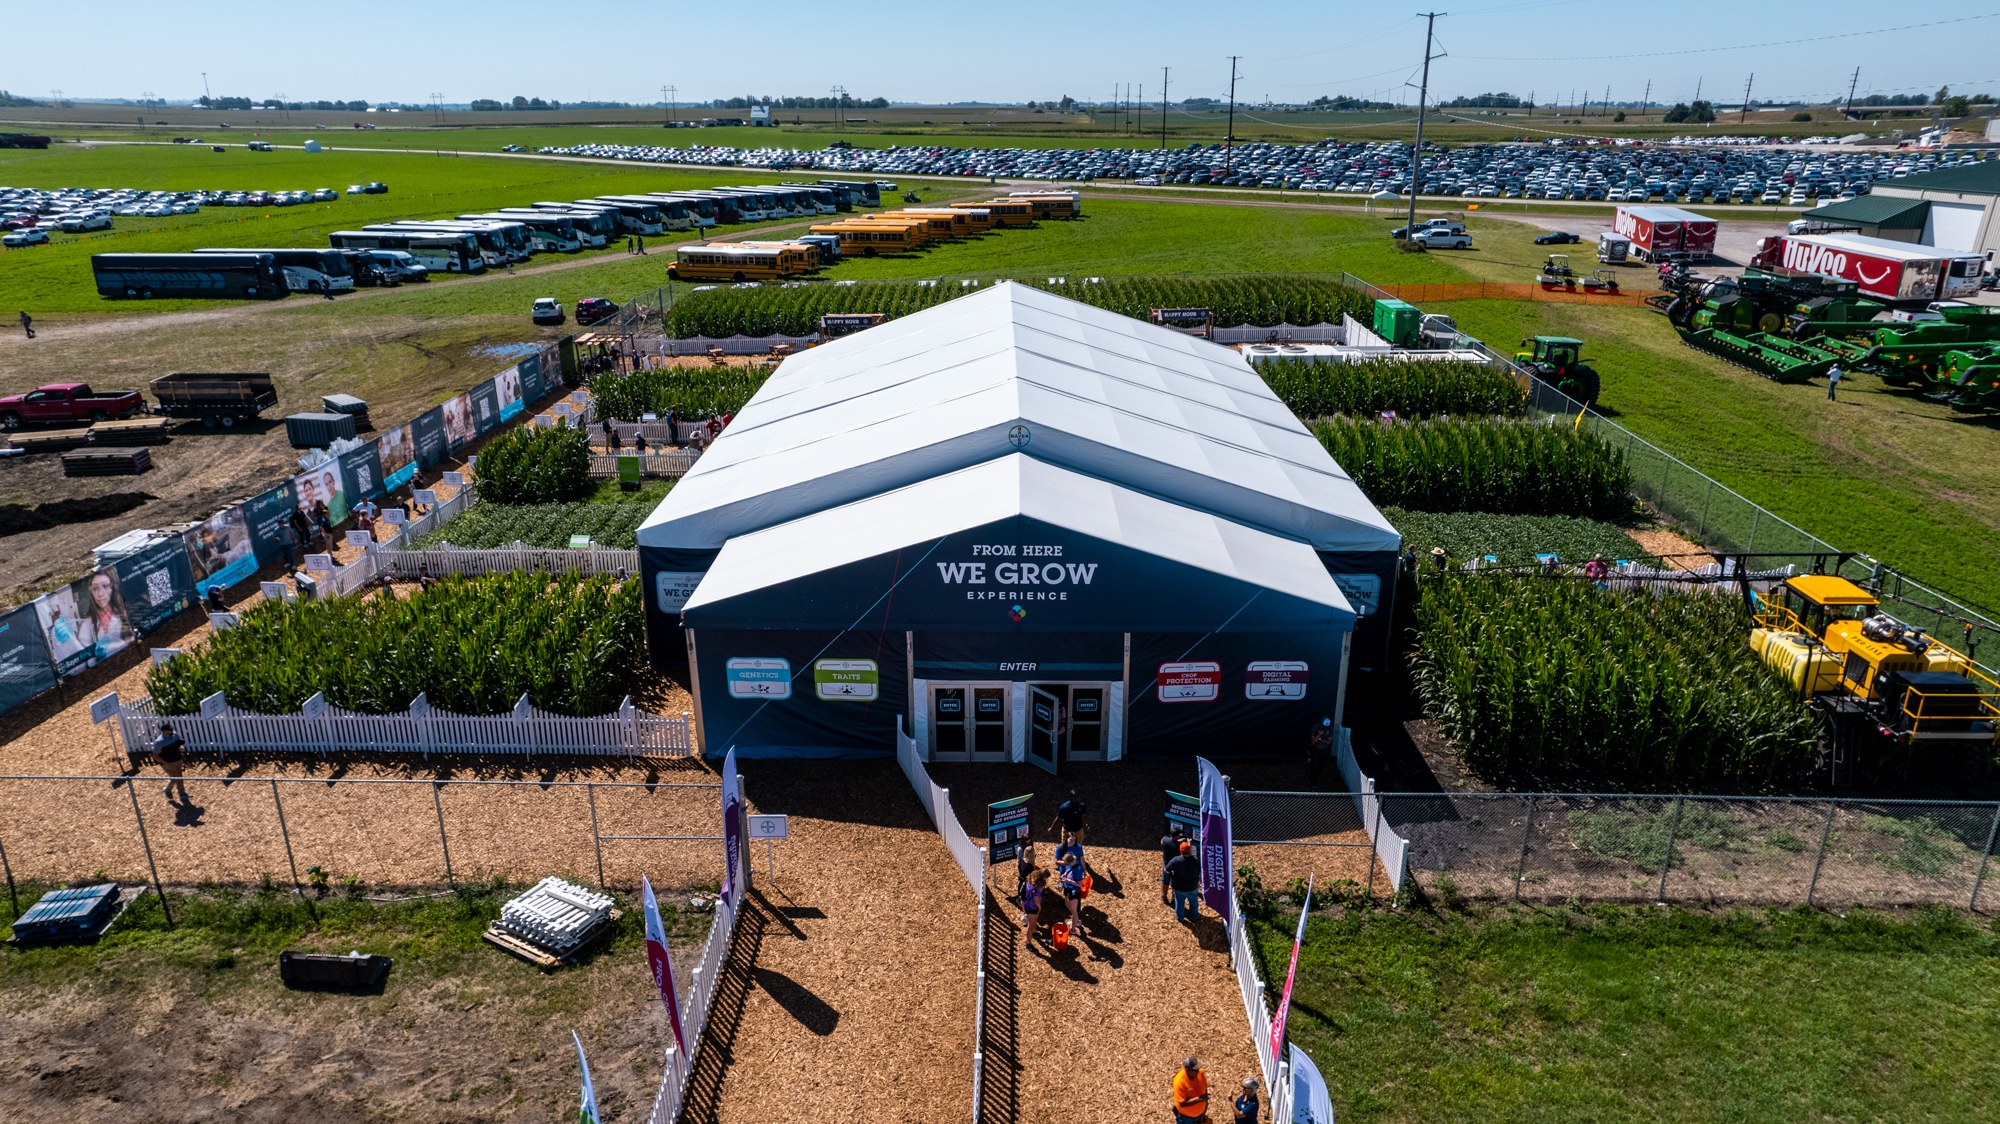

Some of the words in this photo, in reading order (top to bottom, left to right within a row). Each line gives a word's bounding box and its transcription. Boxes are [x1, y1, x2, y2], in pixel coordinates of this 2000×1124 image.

[972, 544, 1016, 556] FROM
[1022, 545, 1063, 556] HERE
[936, 562, 986, 584] WE
[994, 563, 1098, 585] GROW
[967, 591, 1067, 600] EXPERIENCE
[1343, 591, 1372, 599] ROW
[1000, 662, 1037, 671] ENTER
[1207, 846, 1216, 888] FARMING
[1215, 846, 1225, 890] DIGITAL
